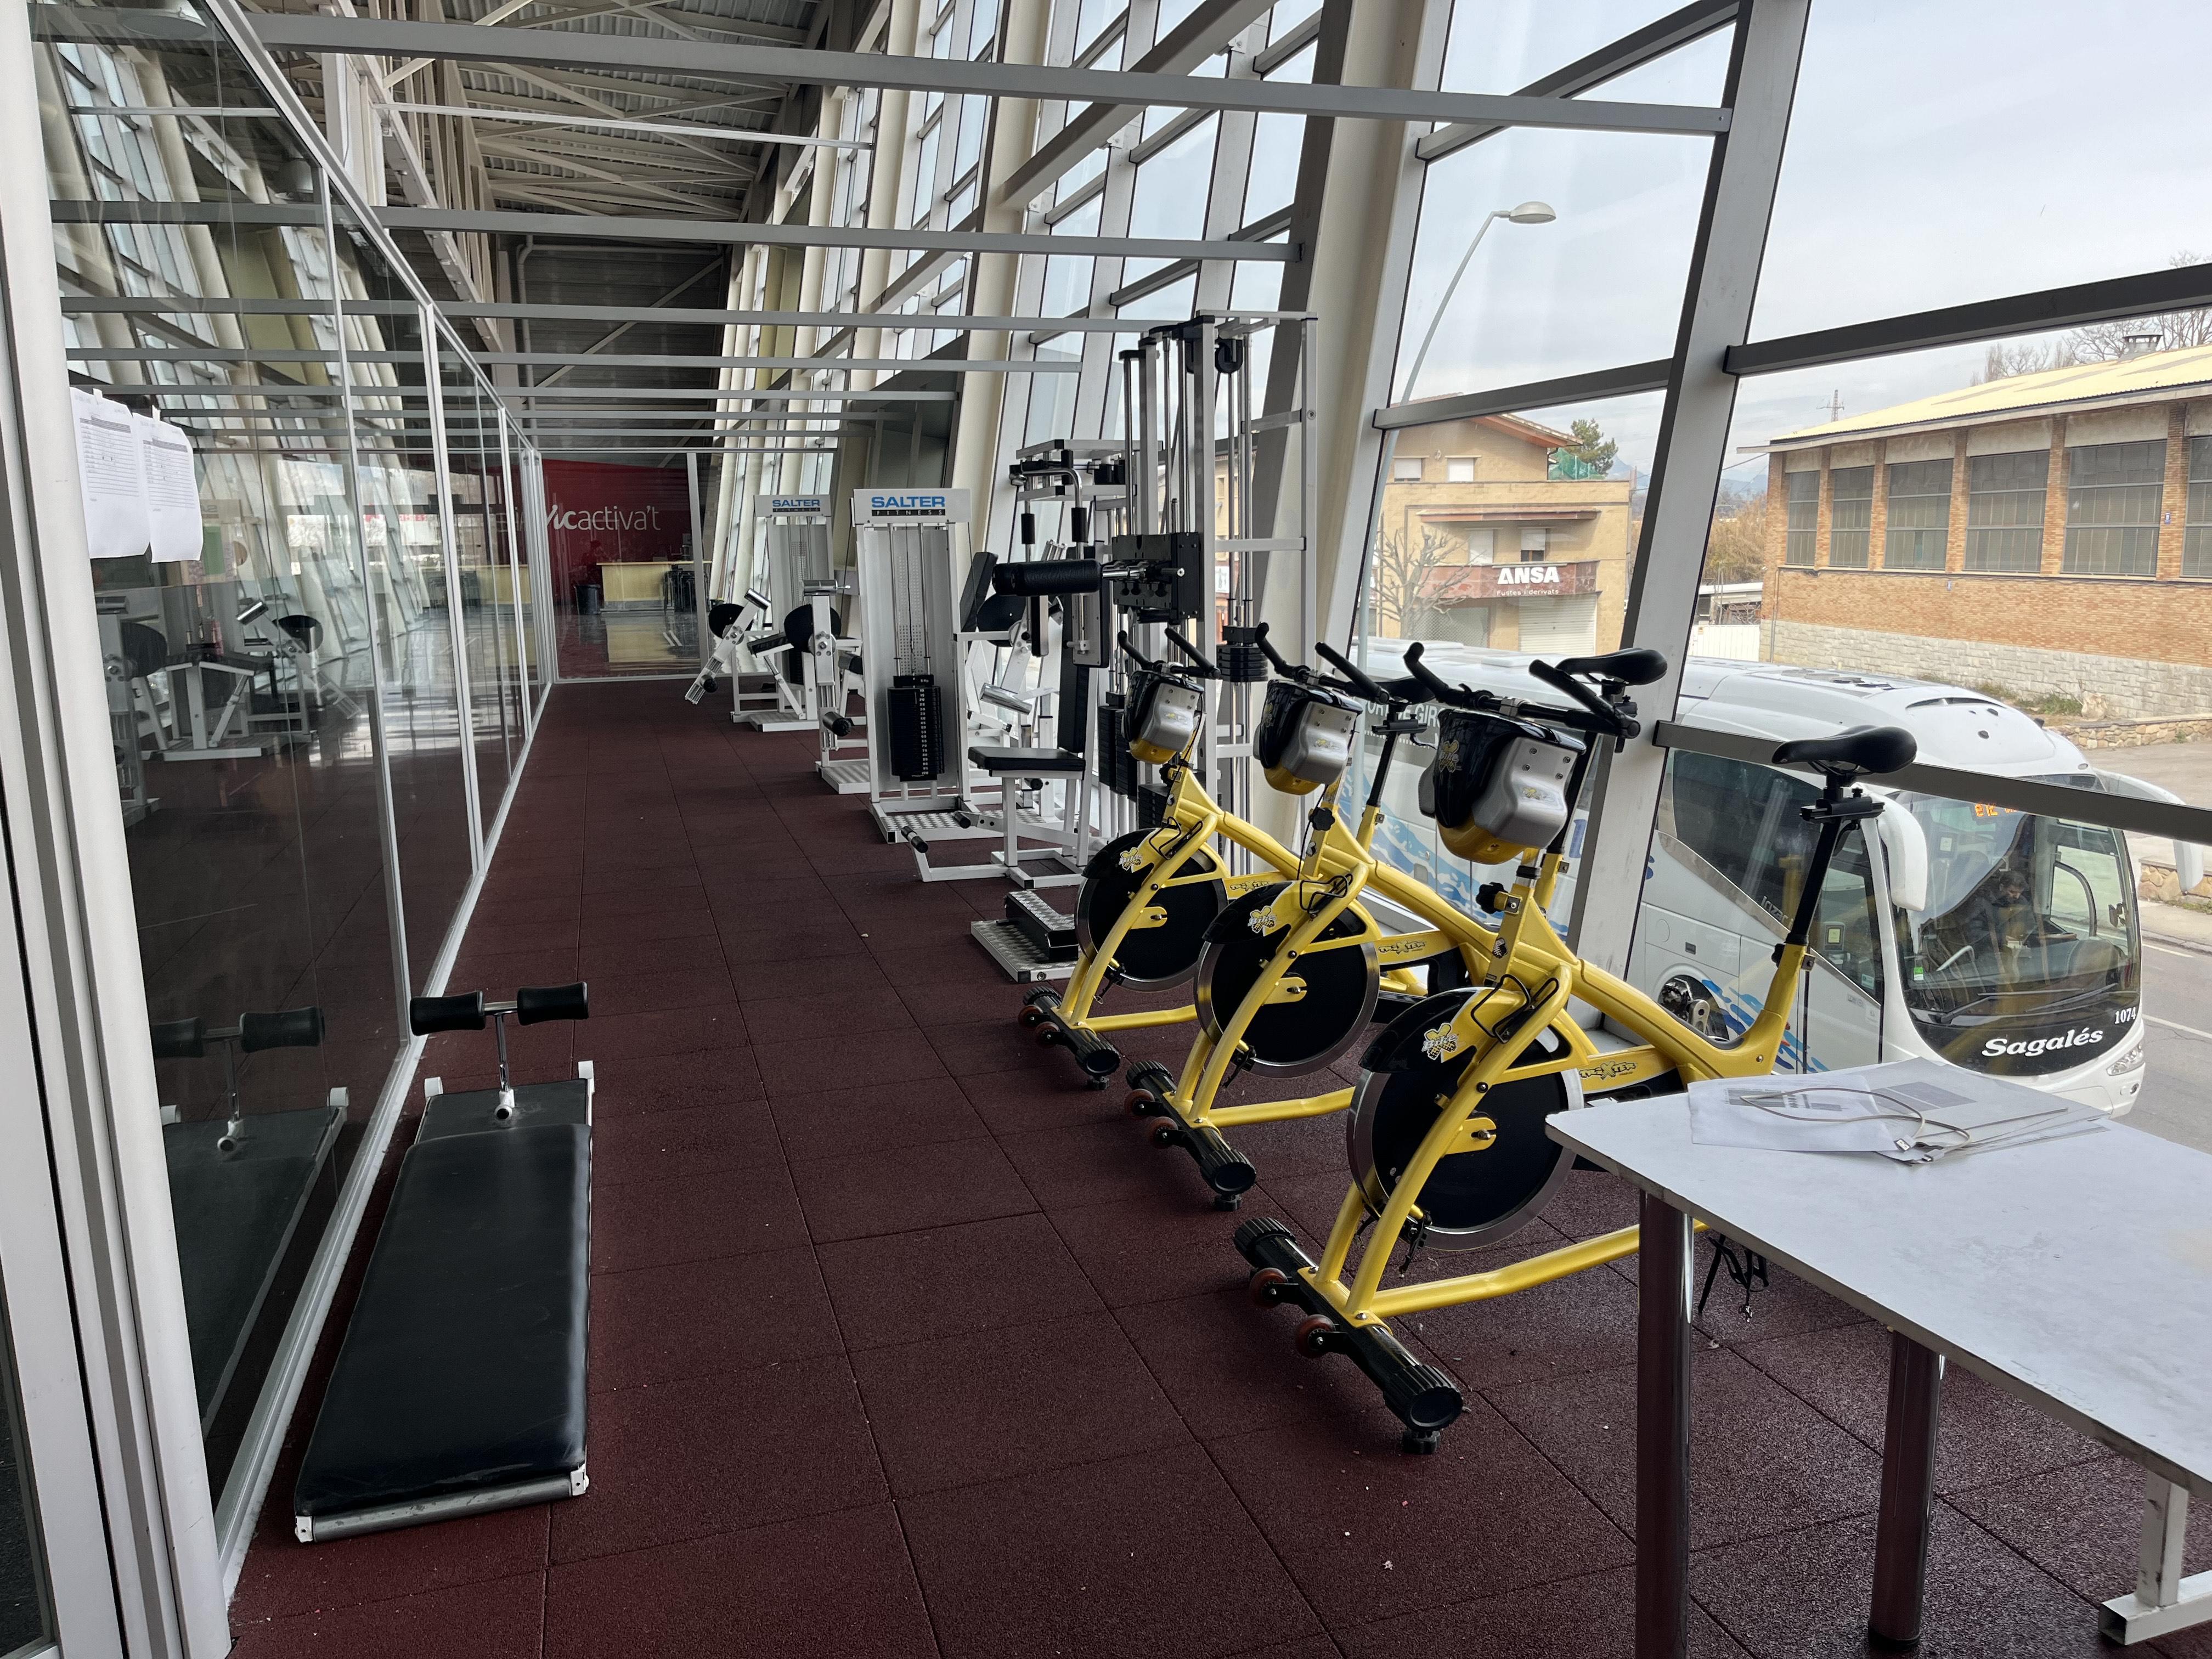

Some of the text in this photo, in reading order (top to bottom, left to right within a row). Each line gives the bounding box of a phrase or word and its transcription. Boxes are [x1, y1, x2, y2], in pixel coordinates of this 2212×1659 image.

[772, 499, 820, 507] SALTER
[871, 496, 945, 508] SALTER
[1497, 566, 1560, 585] ANSA
[2114, 1007, 2136, 1024] 1074
[1982, 1028, 2103, 1057] Sagalés
